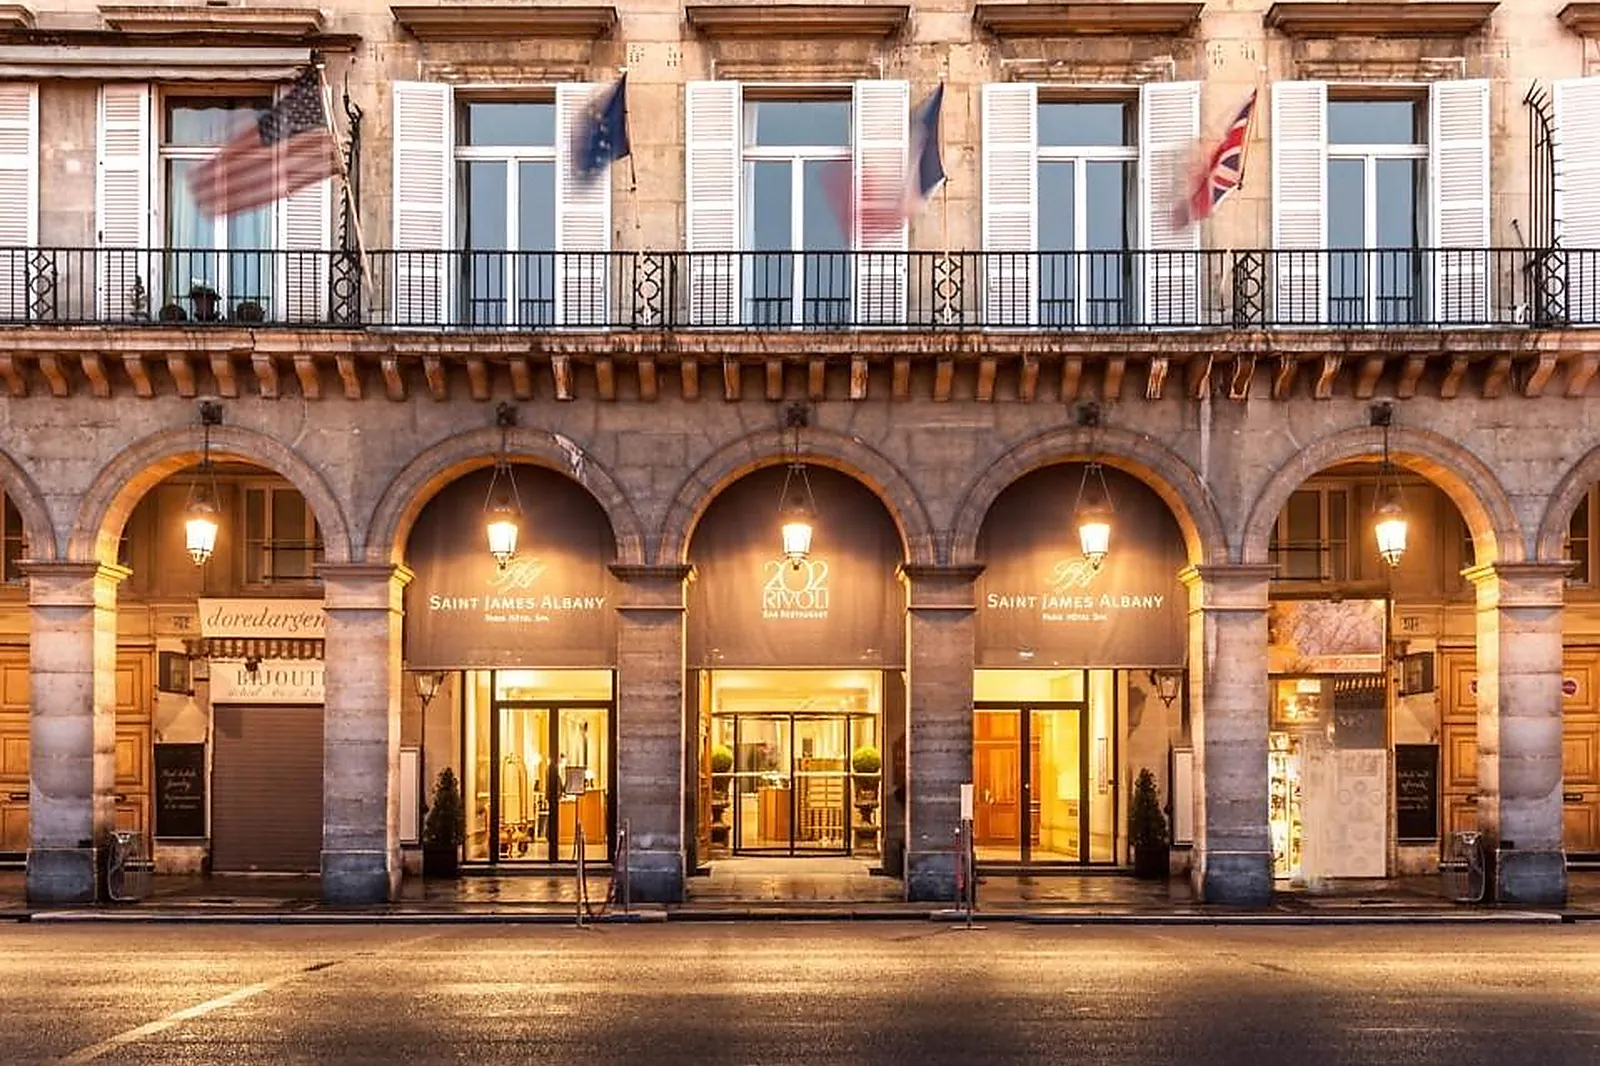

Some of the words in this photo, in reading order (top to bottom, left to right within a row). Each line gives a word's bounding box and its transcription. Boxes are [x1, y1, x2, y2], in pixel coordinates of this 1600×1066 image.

[763, 559, 829, 592] 202
[429, 594, 479, 610] SAINT
[484, 594, 535, 612] JAMES
[540, 594, 606, 610] ALBANY
[763, 590, 829, 609] RIVOLI
[987, 593, 1037, 608] SAINT
[1042, 593, 1095, 611] JAMES
[1099, 593, 1165, 608] ALBANY
